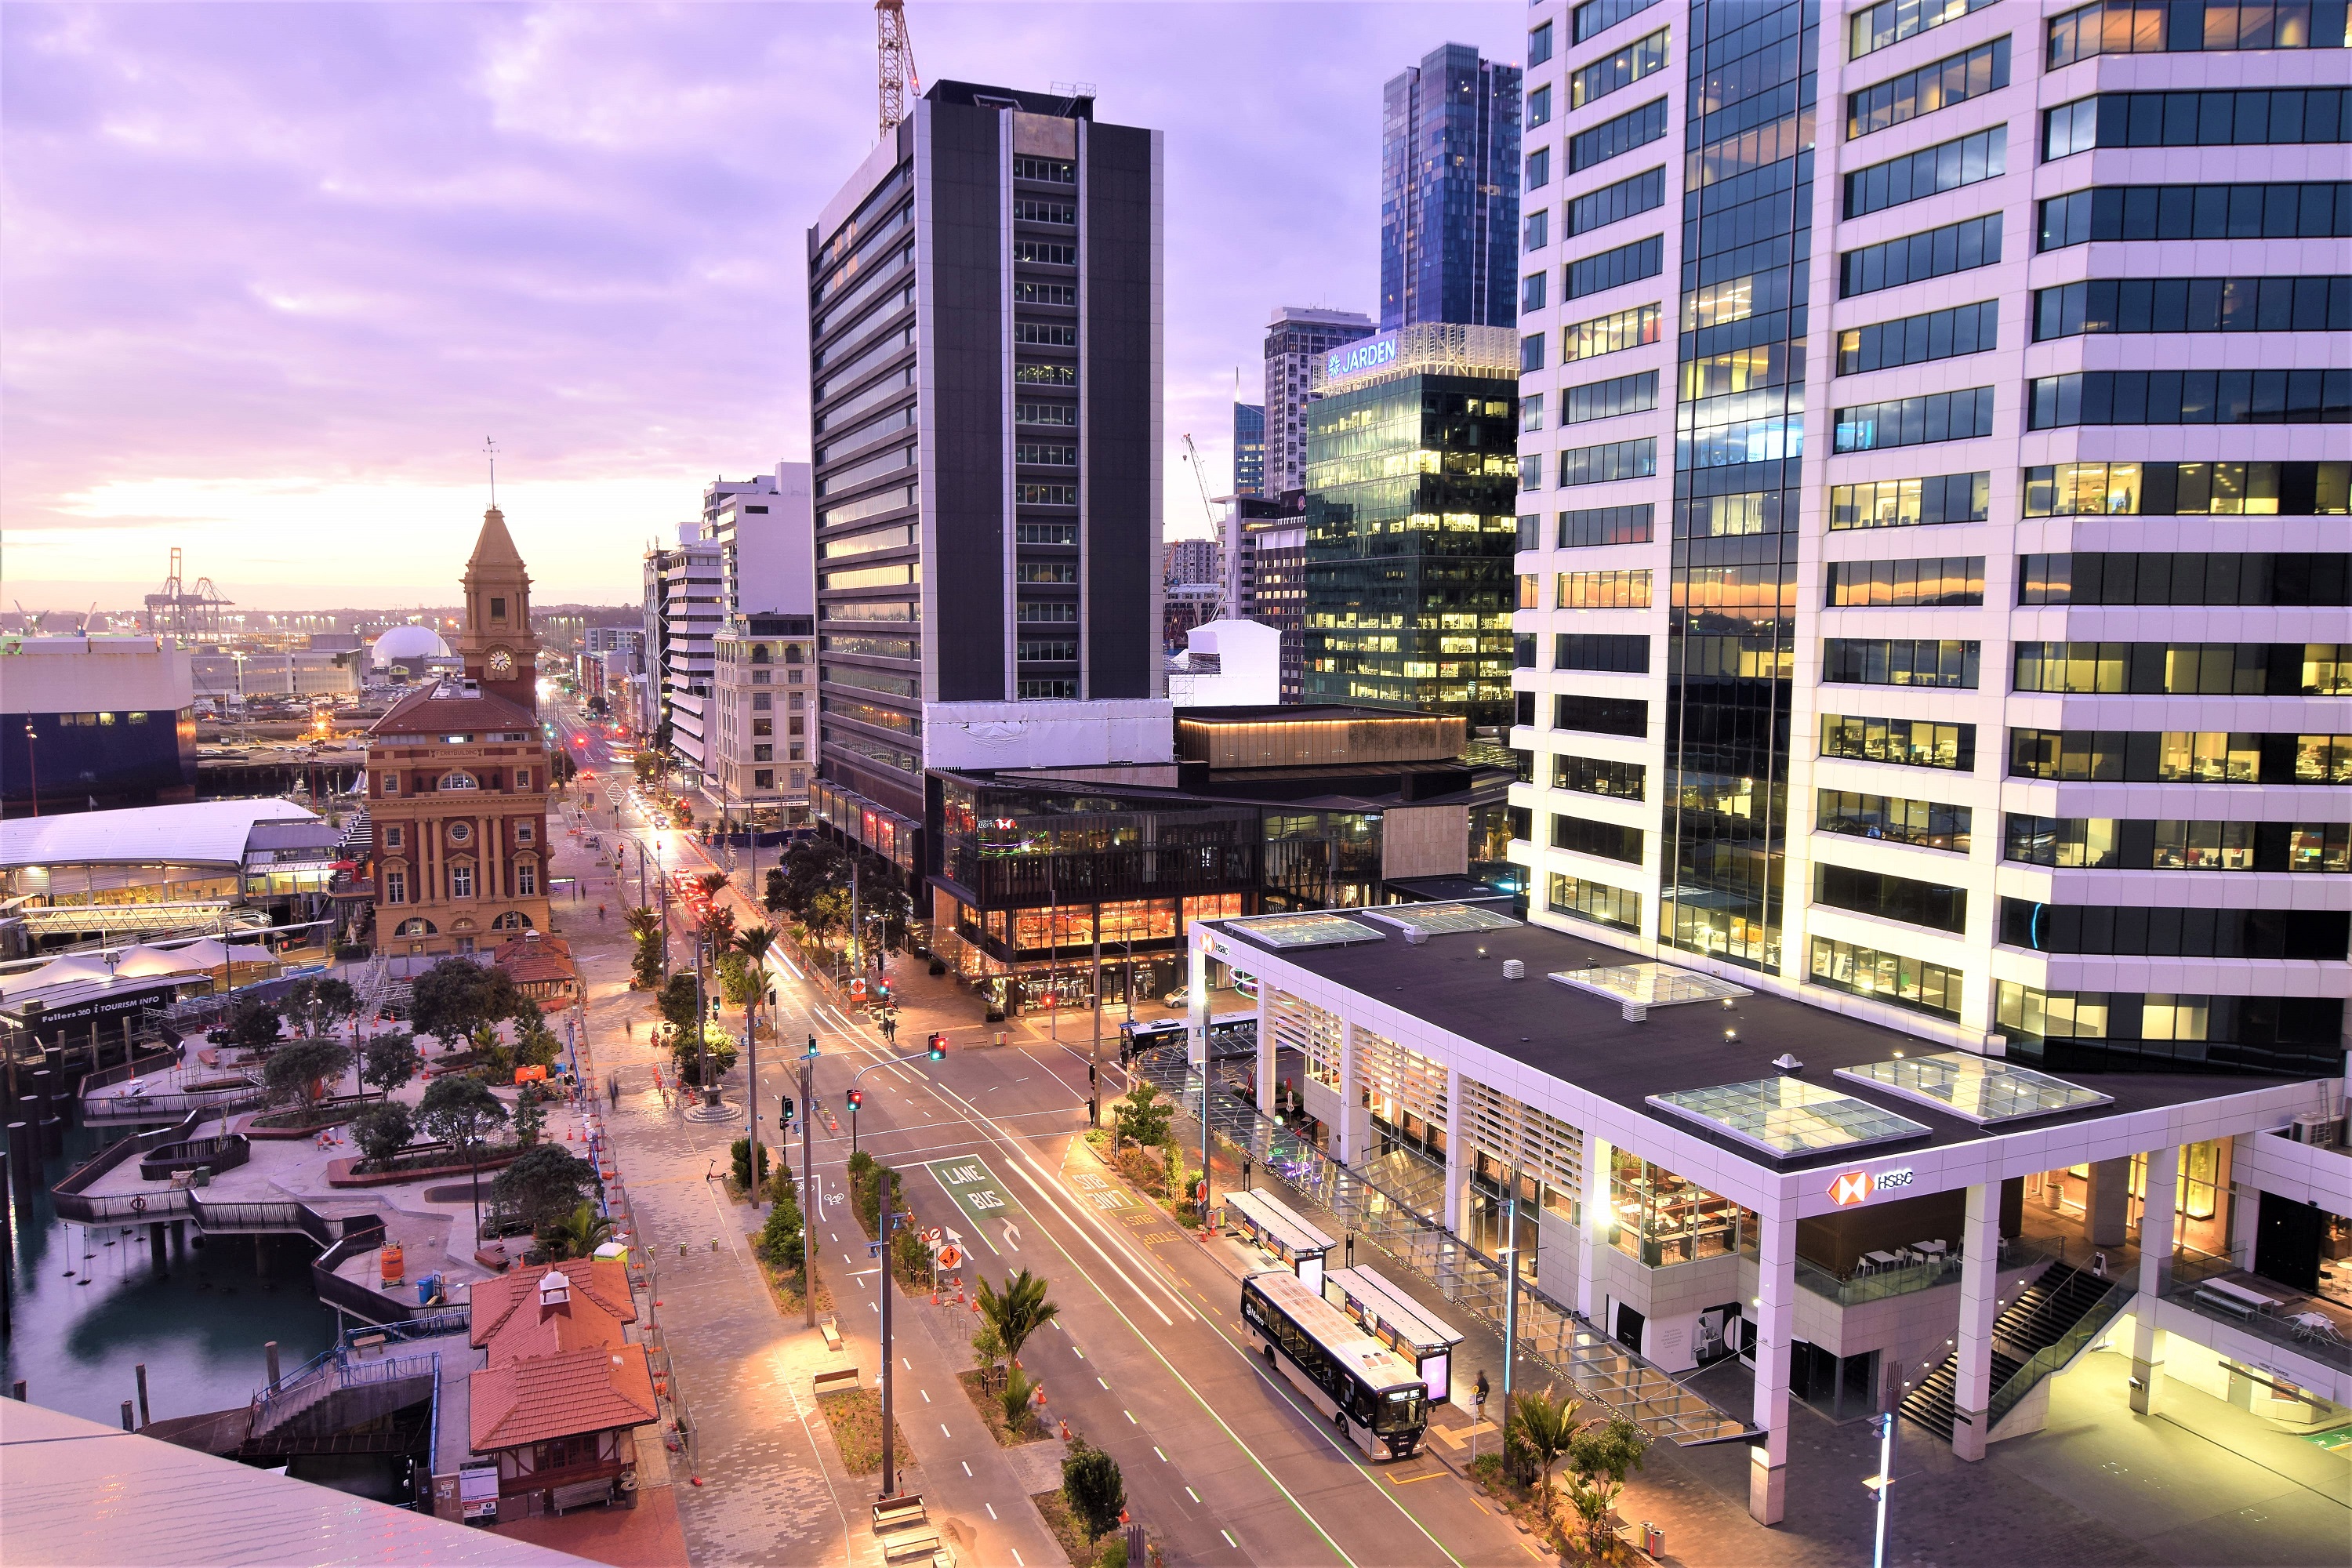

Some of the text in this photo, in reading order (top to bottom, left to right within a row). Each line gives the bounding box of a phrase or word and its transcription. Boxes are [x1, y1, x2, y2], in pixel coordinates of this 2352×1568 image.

[1342, 338, 1396, 374] JARDEN
[42, 1012, 77, 1022] Fullers
[100, 1000, 137, 1012] TOURISM
[140, 996, 160, 1005] INFO
[942, 1164, 986, 1185] LANE
[1072, 1173, 1109, 1190] BUS
[1878, 1171, 1913, 1189] HSBC
[967, 1190, 1005, 1210] BUS
[1086, 1189, 1134, 1210] LANE
[1125, 1214, 1158, 1225] BUS
[1143, 1230, 1182, 1244] STOP
[2259, 1362, 2272, 1370] HSBC
[2273, 1367, 2289, 1377] TOWER
